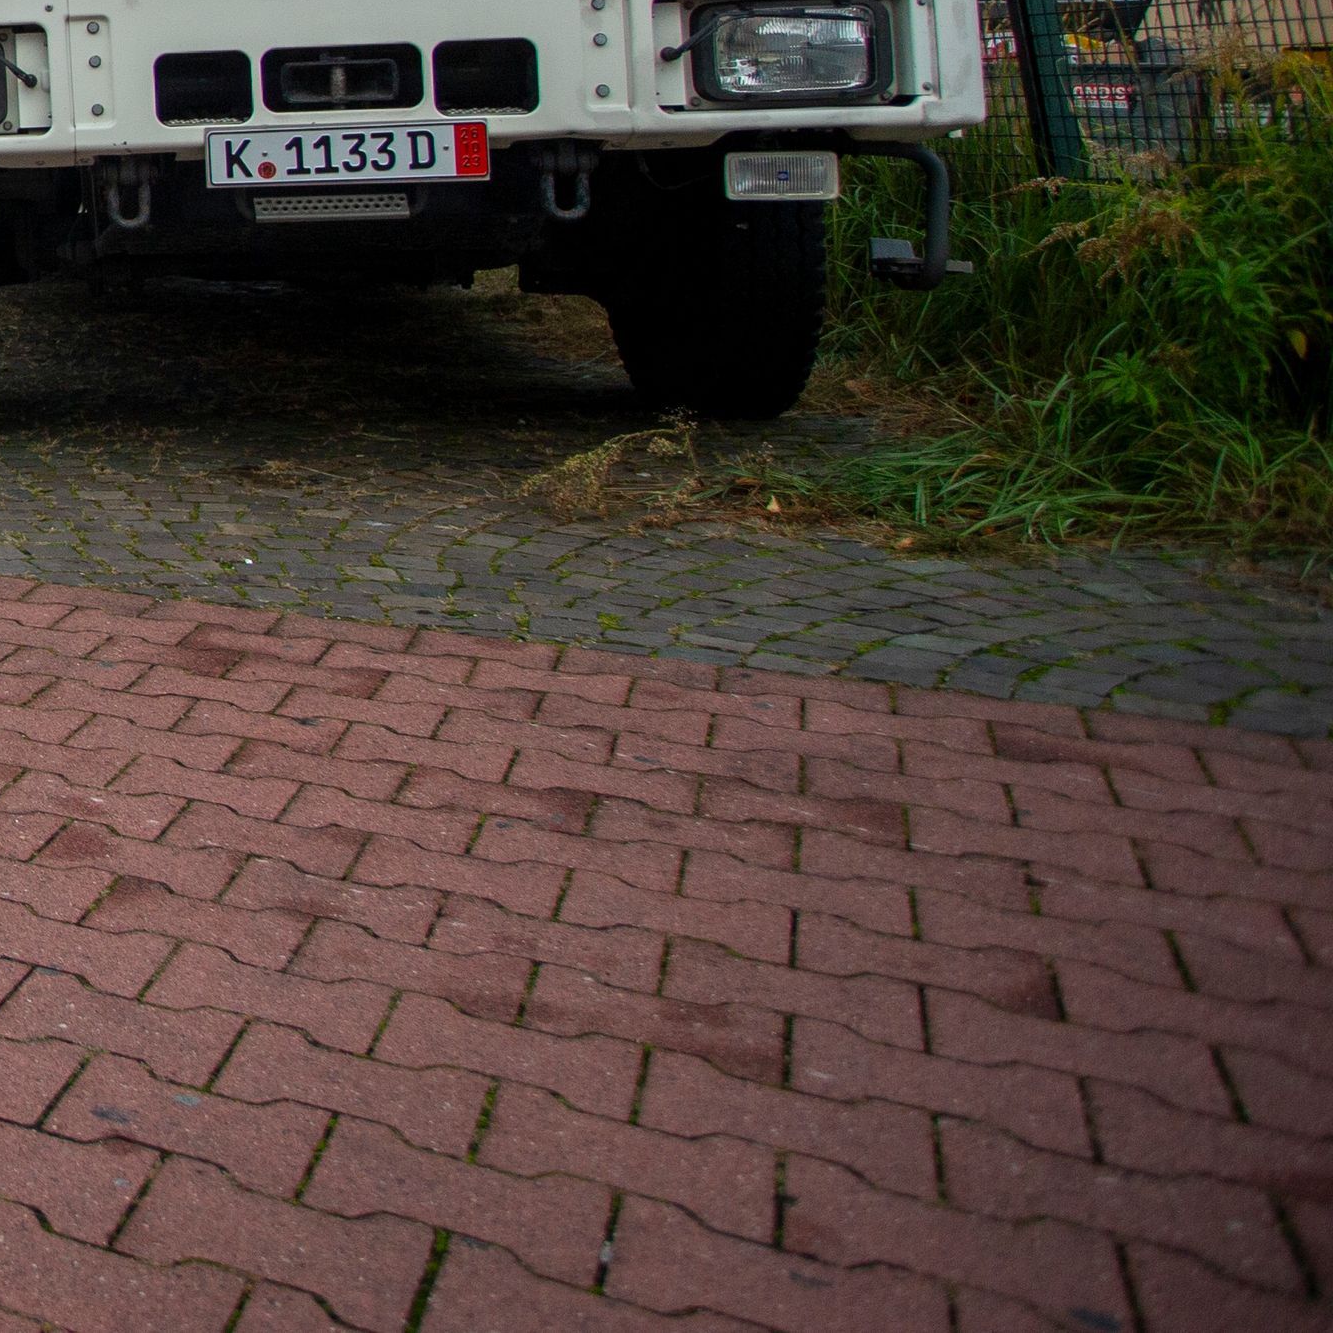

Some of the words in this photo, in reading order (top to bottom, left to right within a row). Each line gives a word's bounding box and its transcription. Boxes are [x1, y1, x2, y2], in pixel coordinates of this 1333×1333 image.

[224, 139, 253, 178] K
[284, 131, 397, 175] 1133
[406, 130, 436, 170] D
